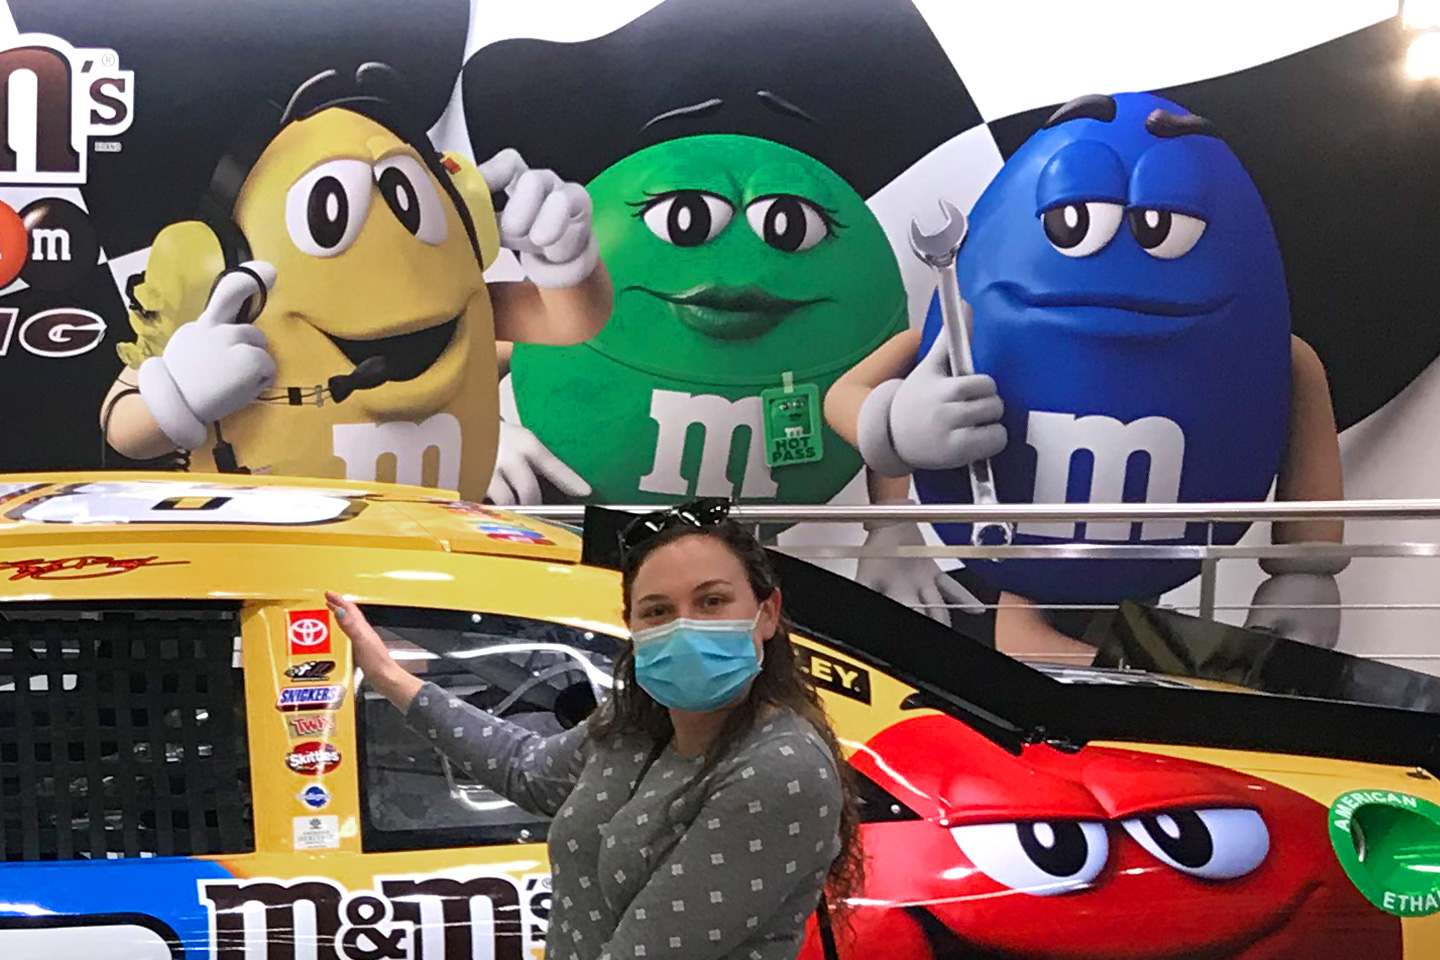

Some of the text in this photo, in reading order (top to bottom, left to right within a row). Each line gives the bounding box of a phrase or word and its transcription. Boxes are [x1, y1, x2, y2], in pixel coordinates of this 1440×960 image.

[31, 226, 72, 261] m
[333, 412, 460, 492] m
[638, 388, 779, 499] m
[772, 446, 816, 461] PASS
[775, 438, 808, 450] HOT
[1016, 409, 1187, 541] m
[280, 687, 338, 703] SNICKERS
[289, 750, 340, 767] Skittles
[1334, 791, 1418, 834] AMERICAN
